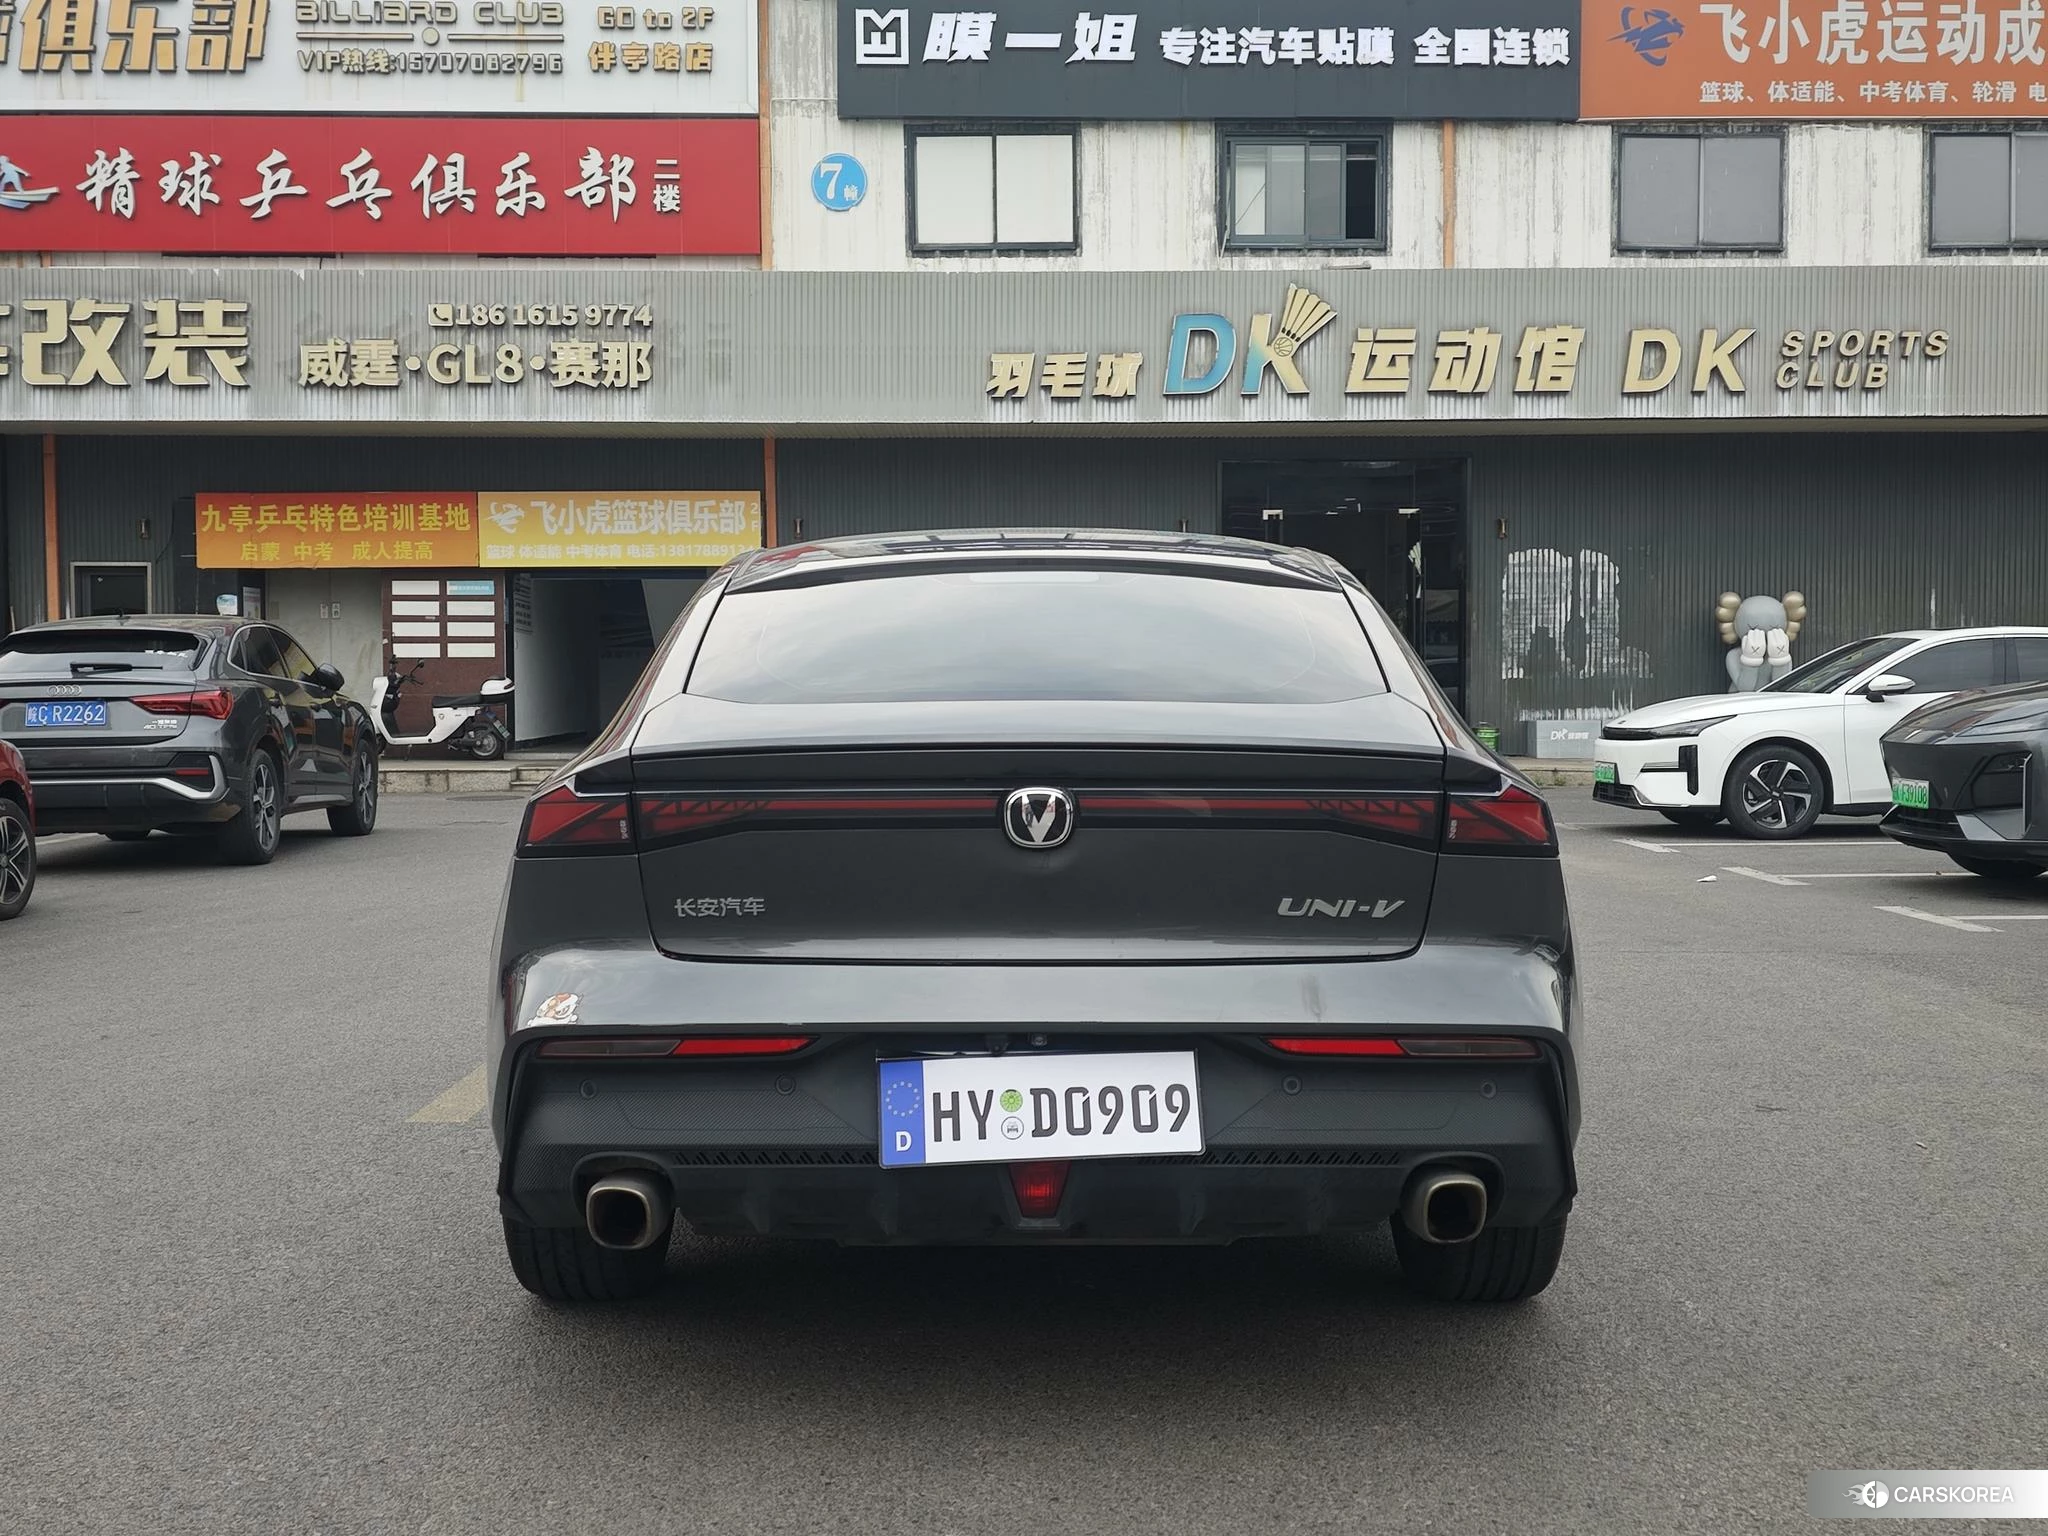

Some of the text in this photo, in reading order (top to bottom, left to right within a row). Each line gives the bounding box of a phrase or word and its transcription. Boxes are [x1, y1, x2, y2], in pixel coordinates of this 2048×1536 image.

[296, 0, 564, 23] BILLIARD CLUB
[643, 9, 673, 29] to
[682, 7, 715, 29] 2F
[0, 0, 270, 72] 俱乐部
[922, 12, 1138, 64] 膜一姐
[1159, 27, 1571, 66] 专注汽车贴膜 全国连锁
[1700, 0, 2046, 65] 飞小虎运动成
[2029, 82, 2048, 103] 电
[76, 146, 637, 223] 精球乒乓俱乐部
[653, 159, 681, 212] 二楼
[456, 304, 653, 326] 186 1615 9774
[0, 299, 249, 387] 改装
[986, 283, 1757, 398] 羽毛球 DK 运动馆 DK
[1781, 329, 1950, 358] SPORTS
[1776, 361, 1890, 389] CLUB
[201, 503, 471, 533] 九亭乒乓特色培训基地
[530, 500, 746, 534] 飞小虎篮球俱乐部
[241, 541, 433, 561] 启蒙 中考 成人提高
[674, 897, 766, 917] 长安汽车
[1277, 898, 1405, 918] UNI-V
[933, 1089, 994, 1142] HY
[896, 1131, 912, 1152] D
